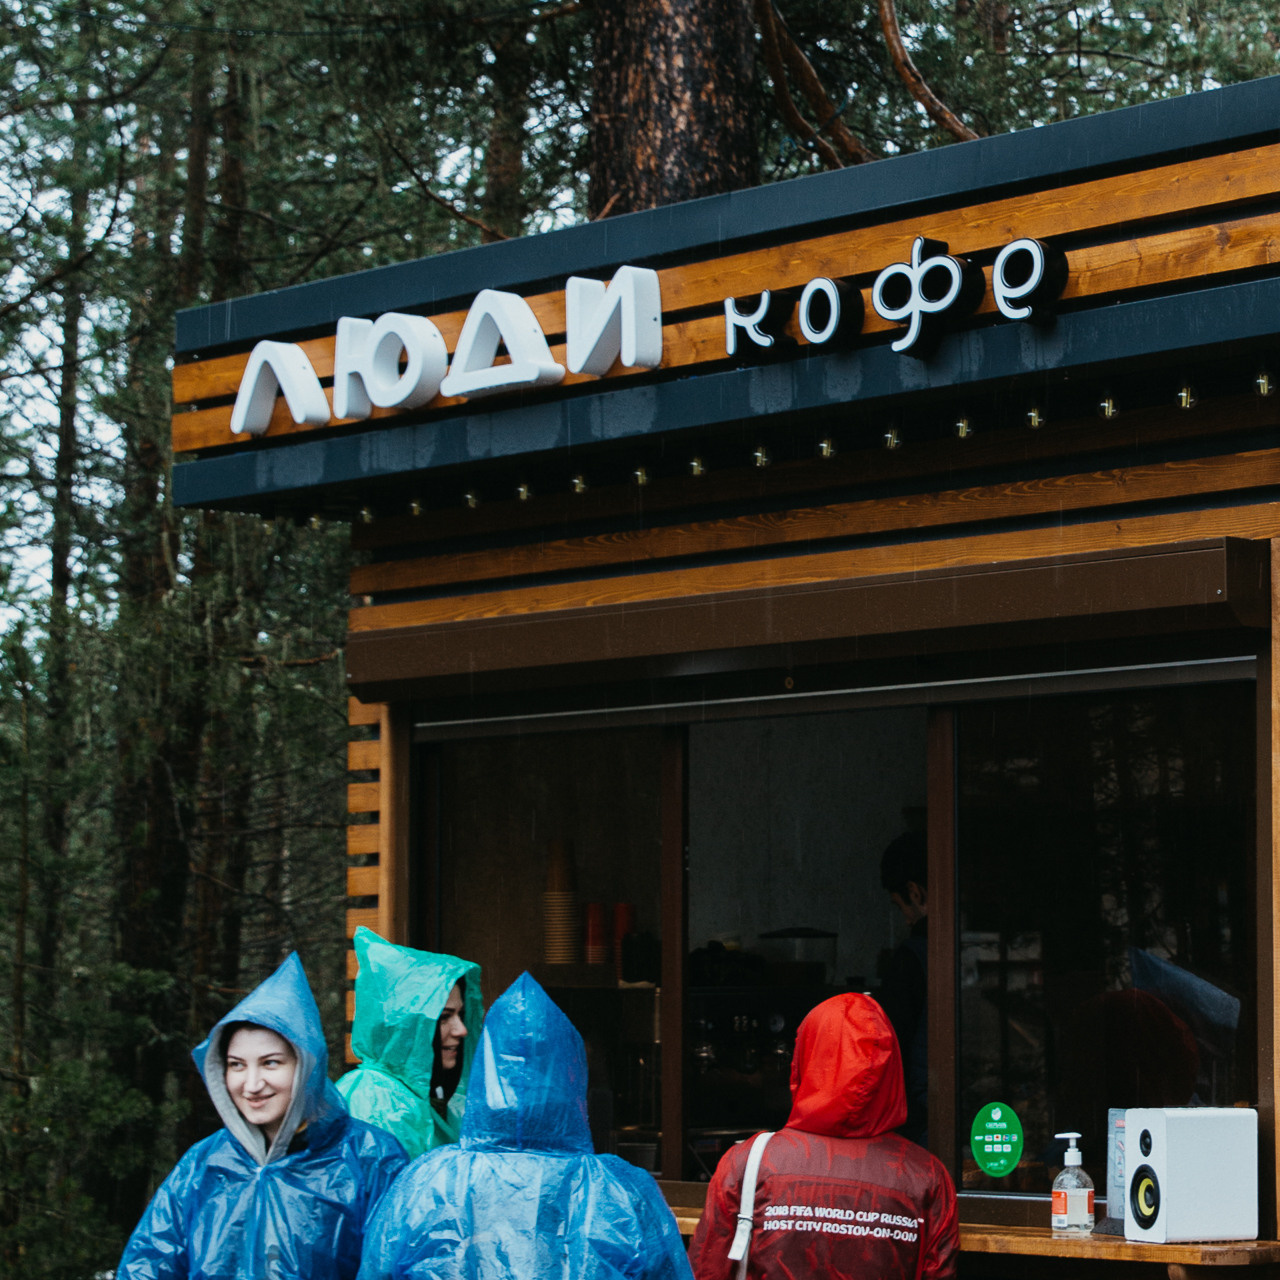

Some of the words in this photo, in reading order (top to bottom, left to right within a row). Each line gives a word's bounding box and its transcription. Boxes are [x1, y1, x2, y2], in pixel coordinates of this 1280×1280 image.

[230, 266, 663, 435] ЛЮДИ
[764, 1206, 789, 1217] 2018
[789, 1205, 813, 1218] FIFA
[814, 1206, 855, 1221] WORLD
[855, 1210, 880, 1223] CUP
[763, 1219, 795, 1231] HOST
[795, 1220, 821, 1232] CITY
[822, 1222, 918, 1242] ROSTOV-ON-DON
